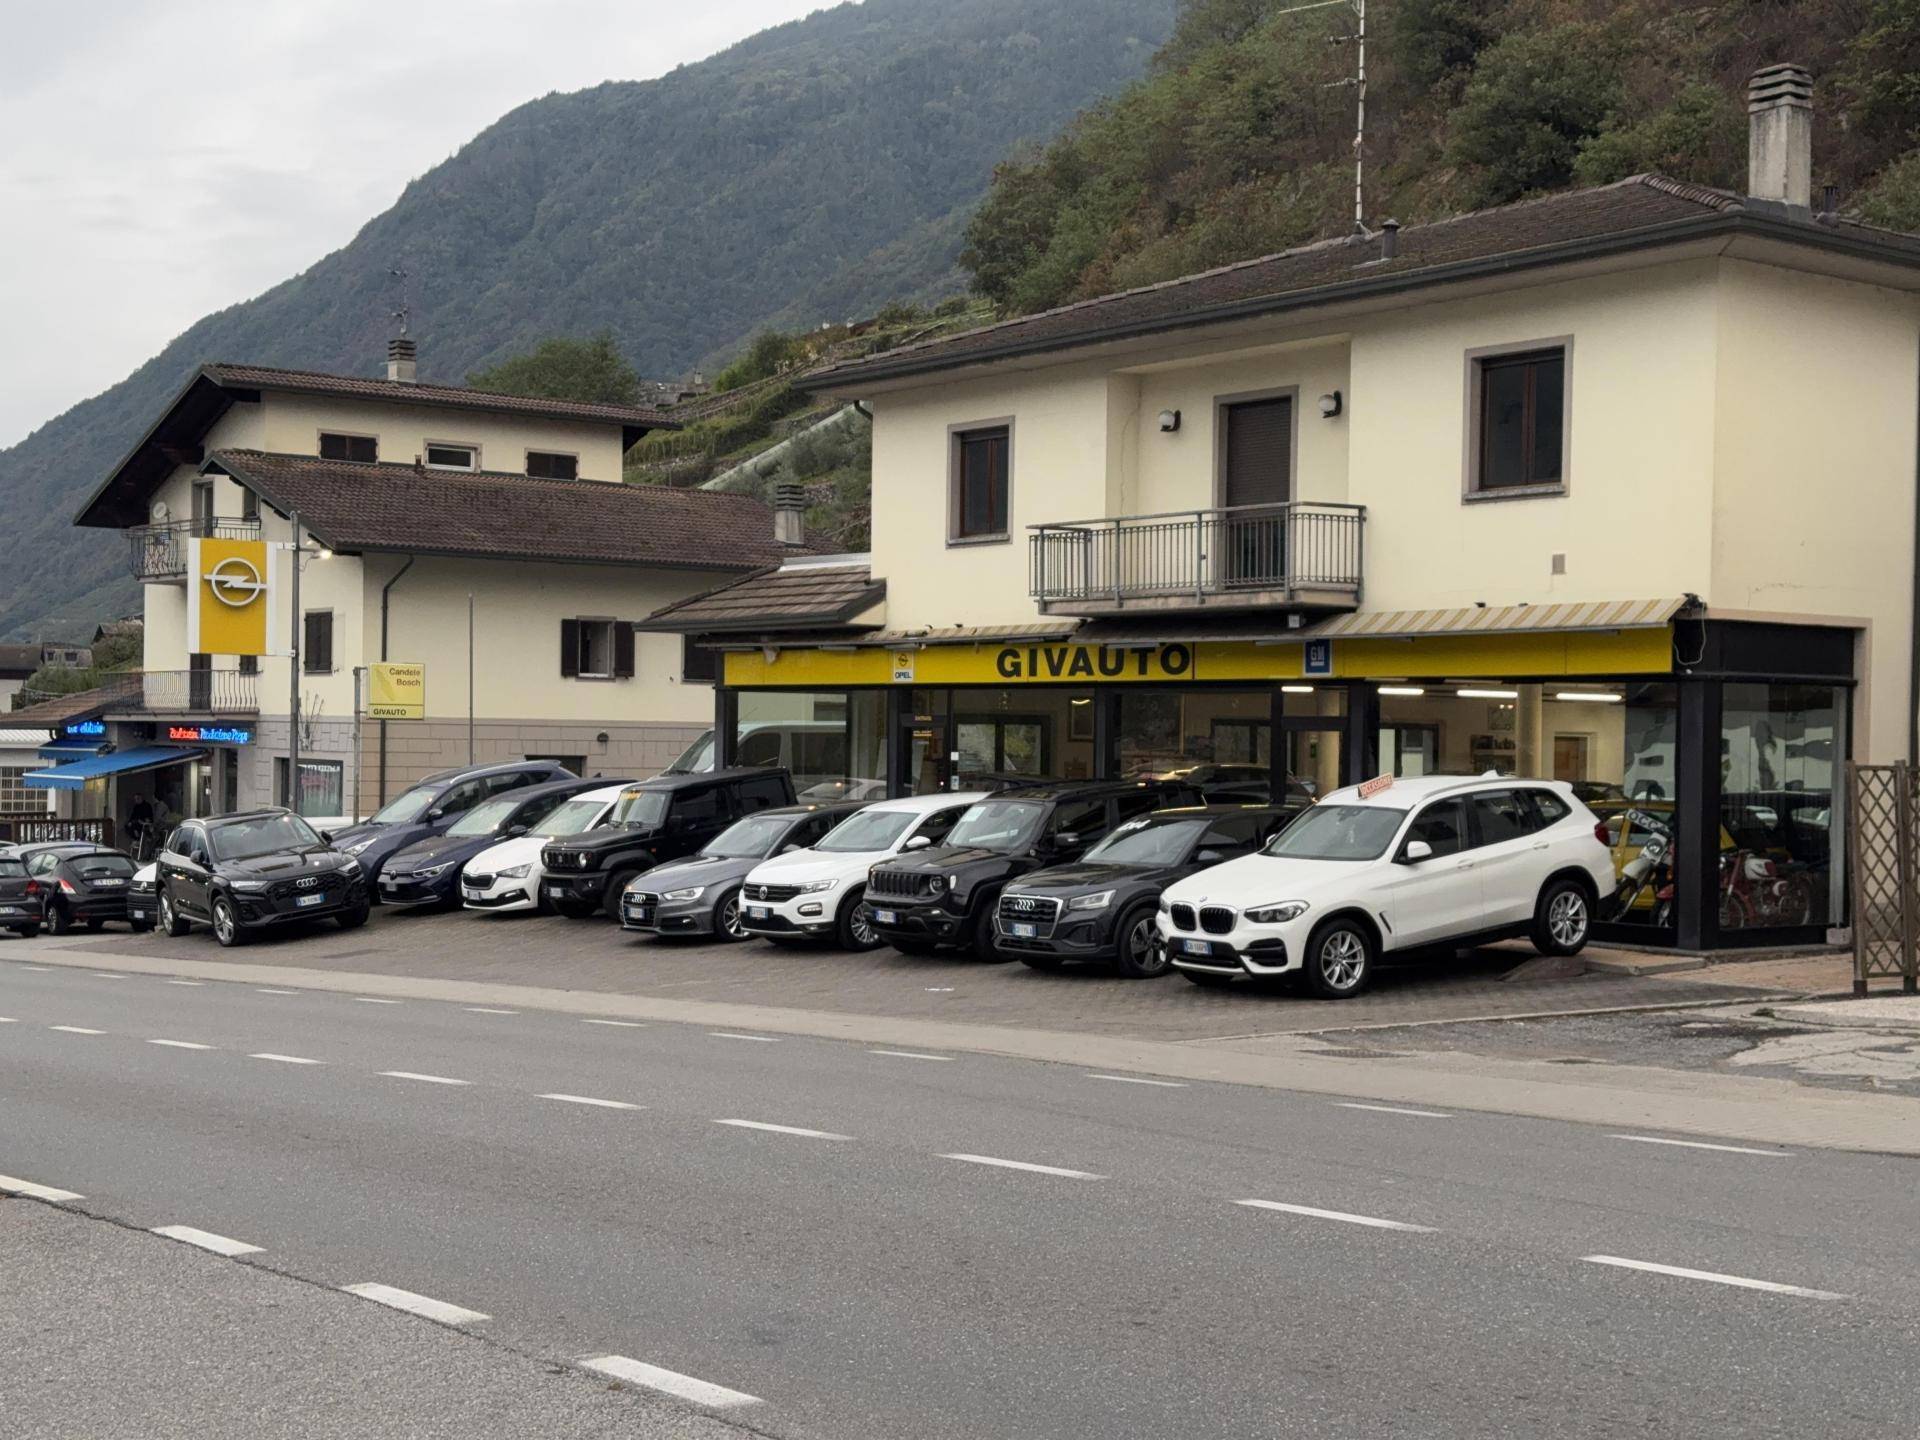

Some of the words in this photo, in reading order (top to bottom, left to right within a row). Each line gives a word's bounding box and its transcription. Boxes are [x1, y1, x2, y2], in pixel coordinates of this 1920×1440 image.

[996, 643, 1190, 678] GIVAUTO
[389, 668, 421, 676] Candele
[895, 671, 912, 679] OPEL
[396, 678, 421, 687] Bosch
[373, 708, 407, 716] GIVAUTO
